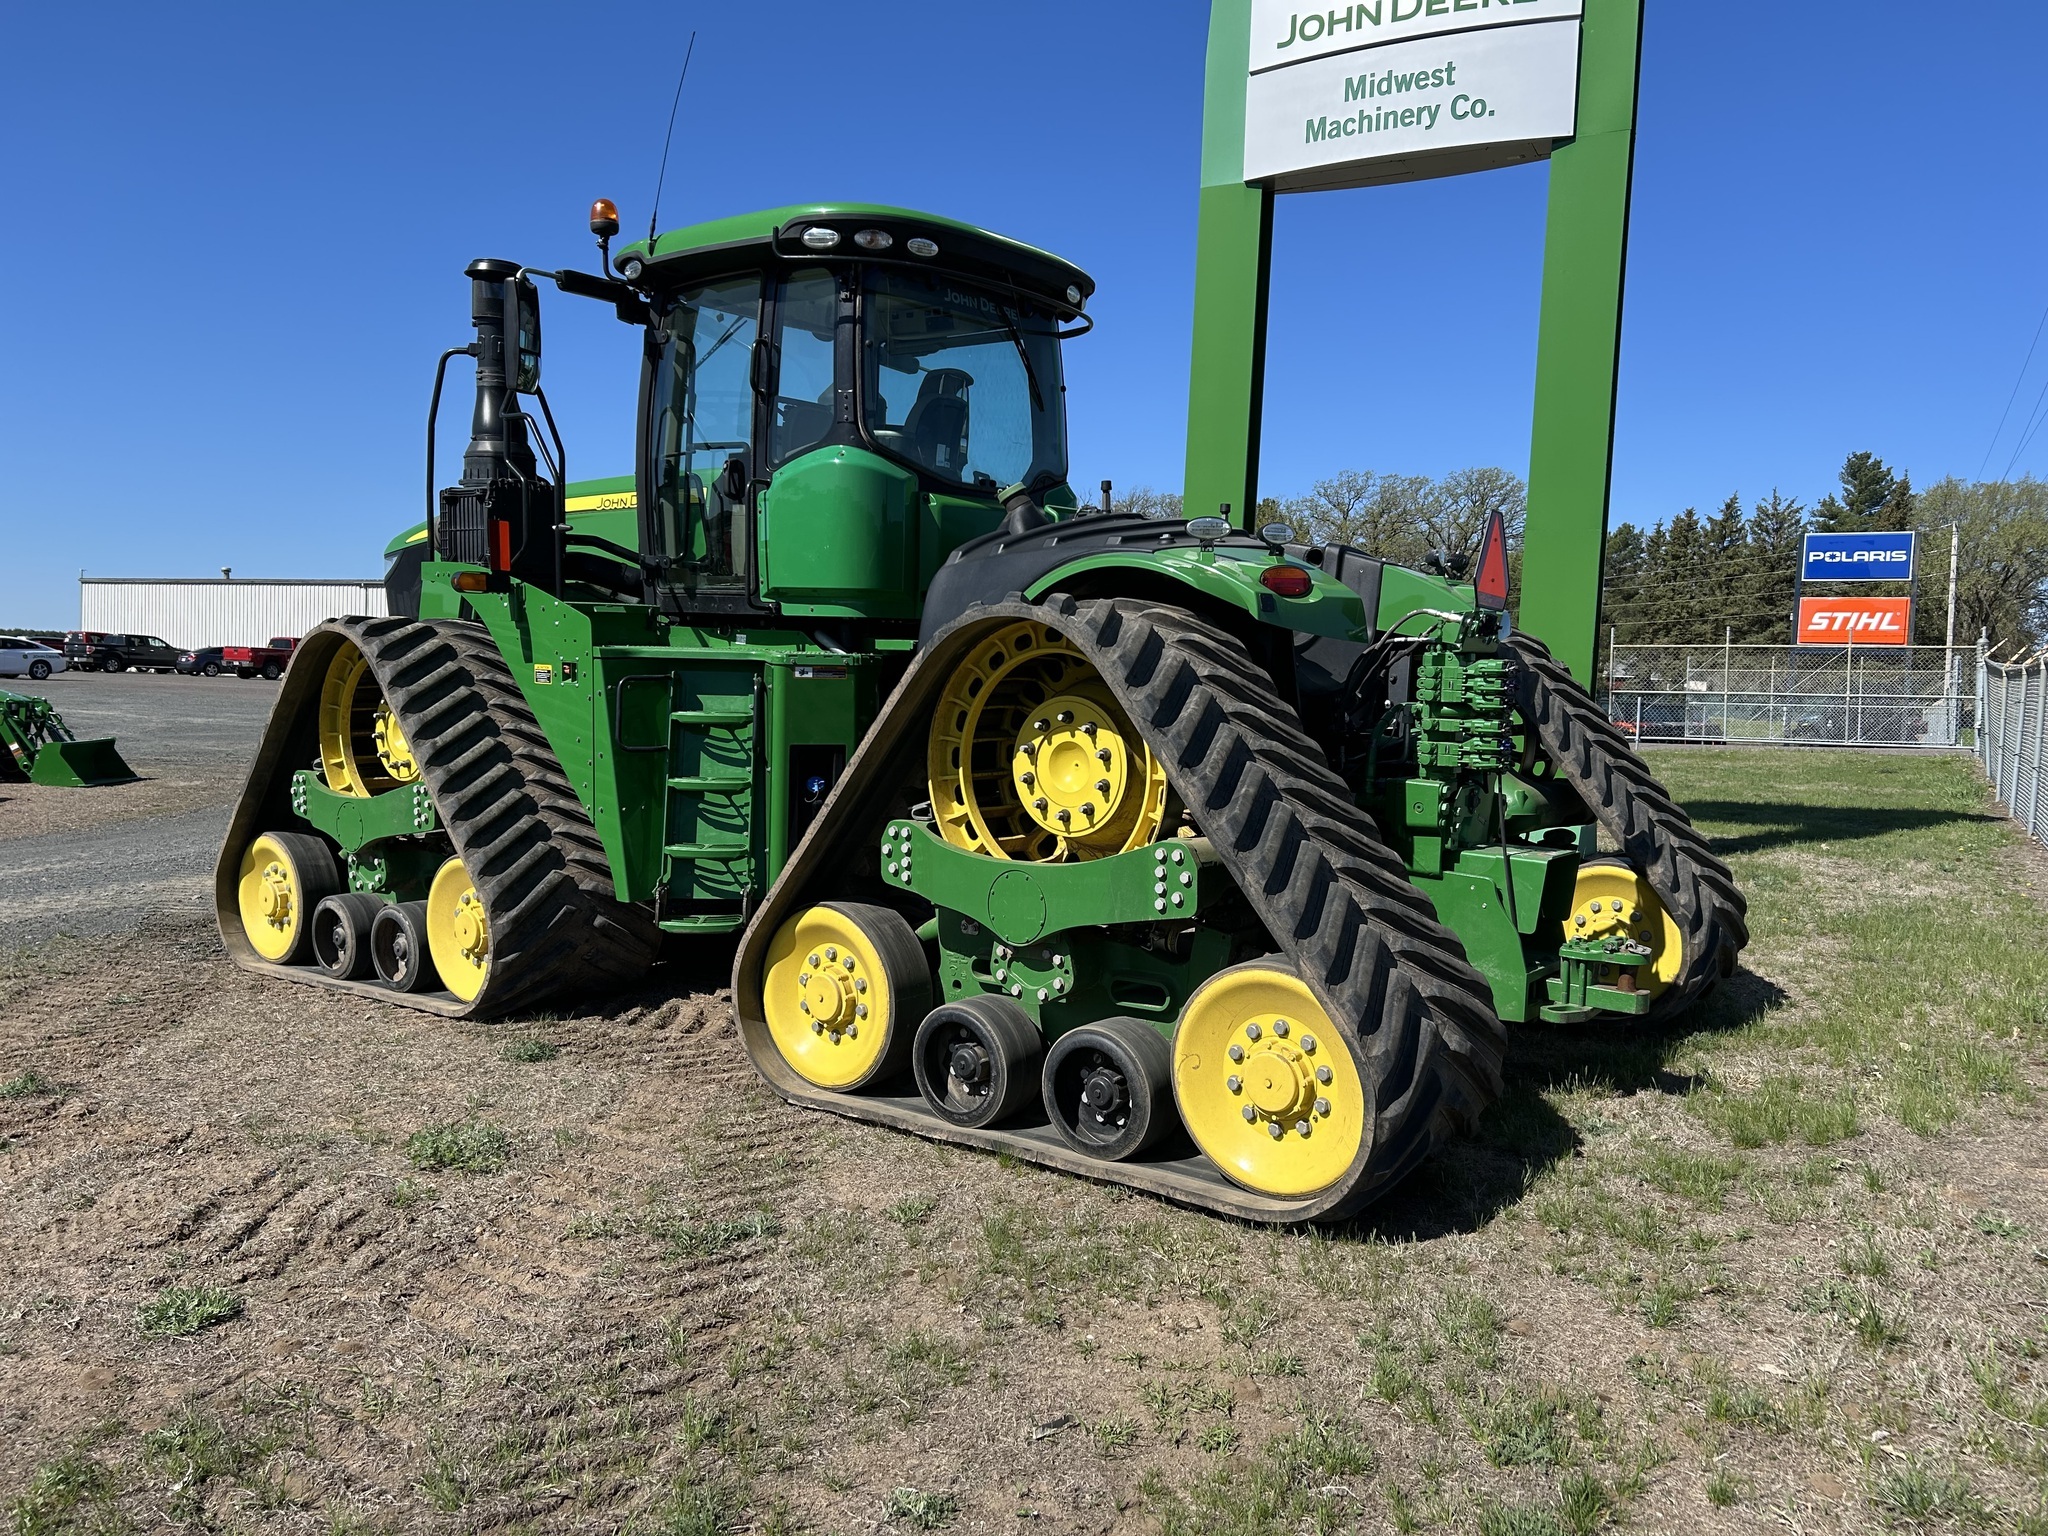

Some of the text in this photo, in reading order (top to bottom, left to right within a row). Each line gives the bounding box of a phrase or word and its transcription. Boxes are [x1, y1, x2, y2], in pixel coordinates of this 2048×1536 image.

[1277, 0, 1382, 50] JOHN
[1344, 61, 1456, 103] Midwest
[1305, 93, 1495, 144] Machinery Co.
[944, 288, 1018, 320] JOHN DERE
[596, 497, 628, 509] JOHN
[1808, 550, 1907, 563] POLARIS
[1807, 611, 1901, 631] STIHL
